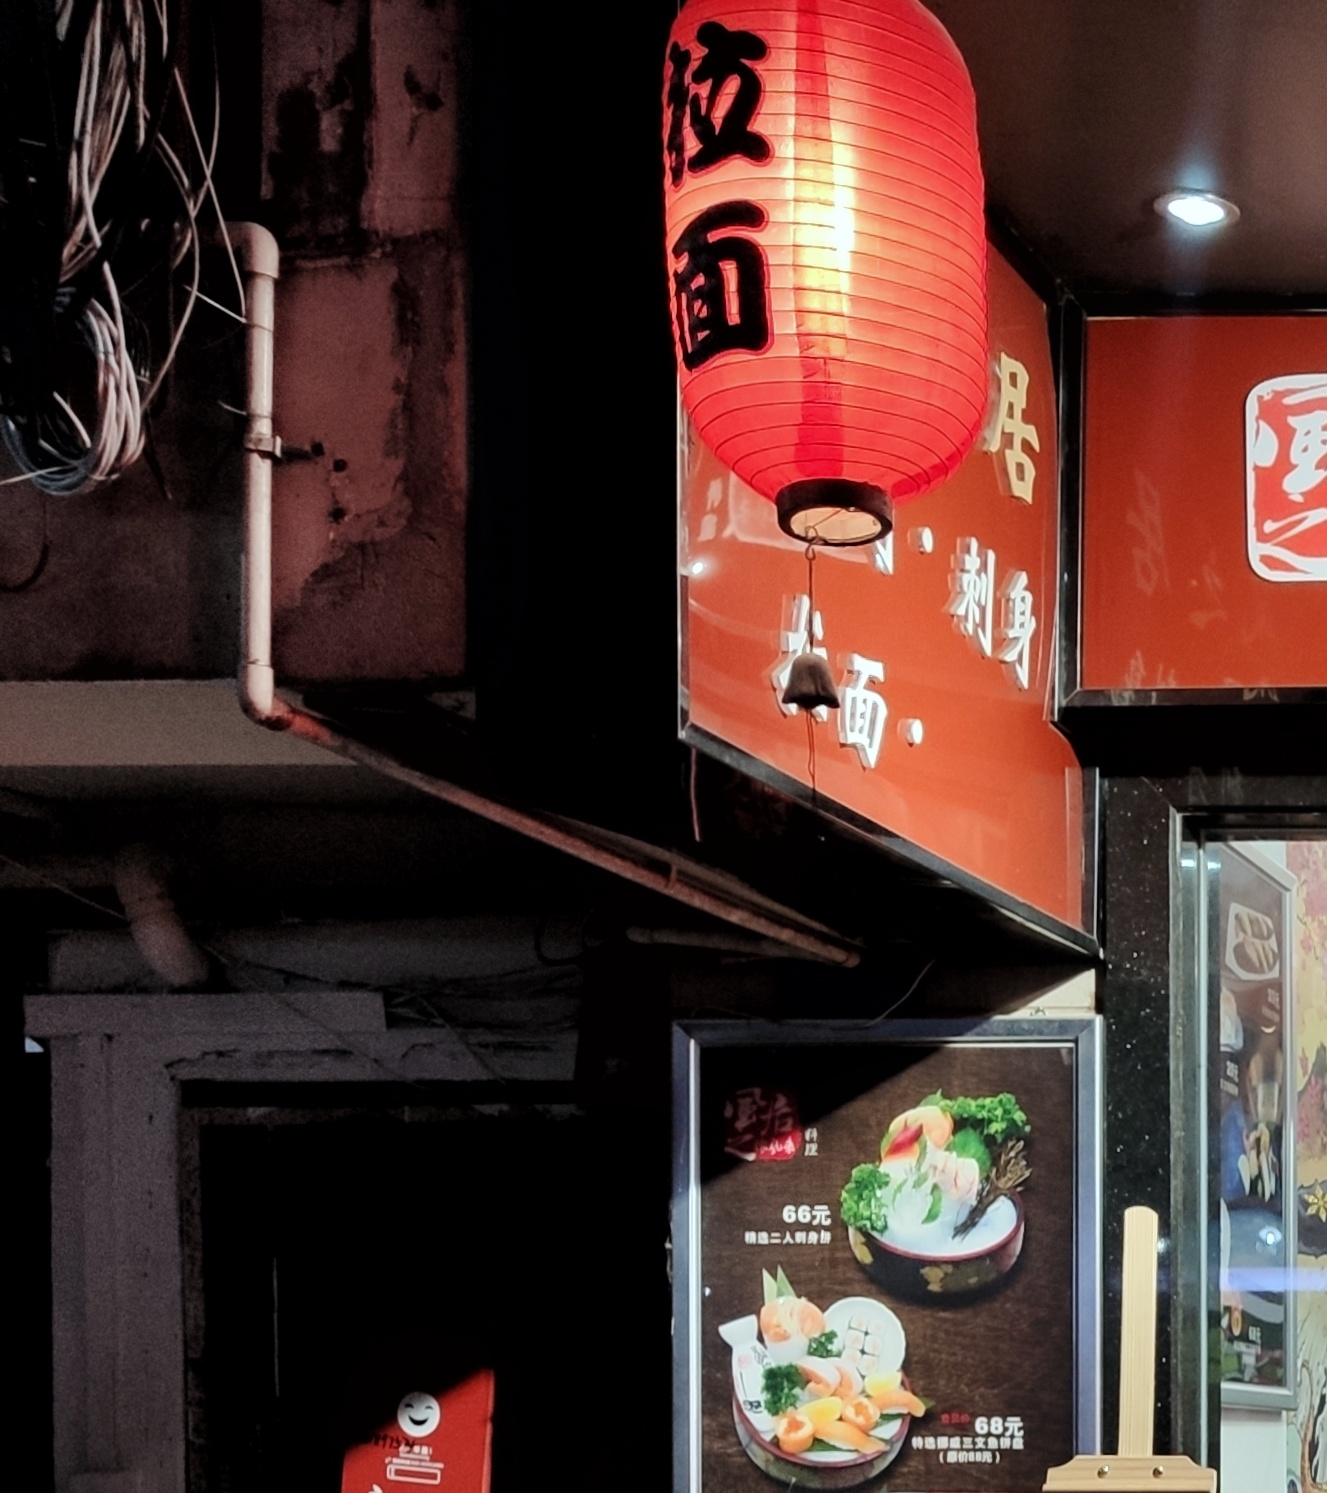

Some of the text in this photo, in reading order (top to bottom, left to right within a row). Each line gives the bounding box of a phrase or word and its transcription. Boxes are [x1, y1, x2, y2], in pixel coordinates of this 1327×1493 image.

[666, 20, 772, 373] 拉面
[947, 536, 1037, 691] 刺身
[782, 1204, 832, 1226] 66元
[974, 1416, 1025, 1437] 68元
